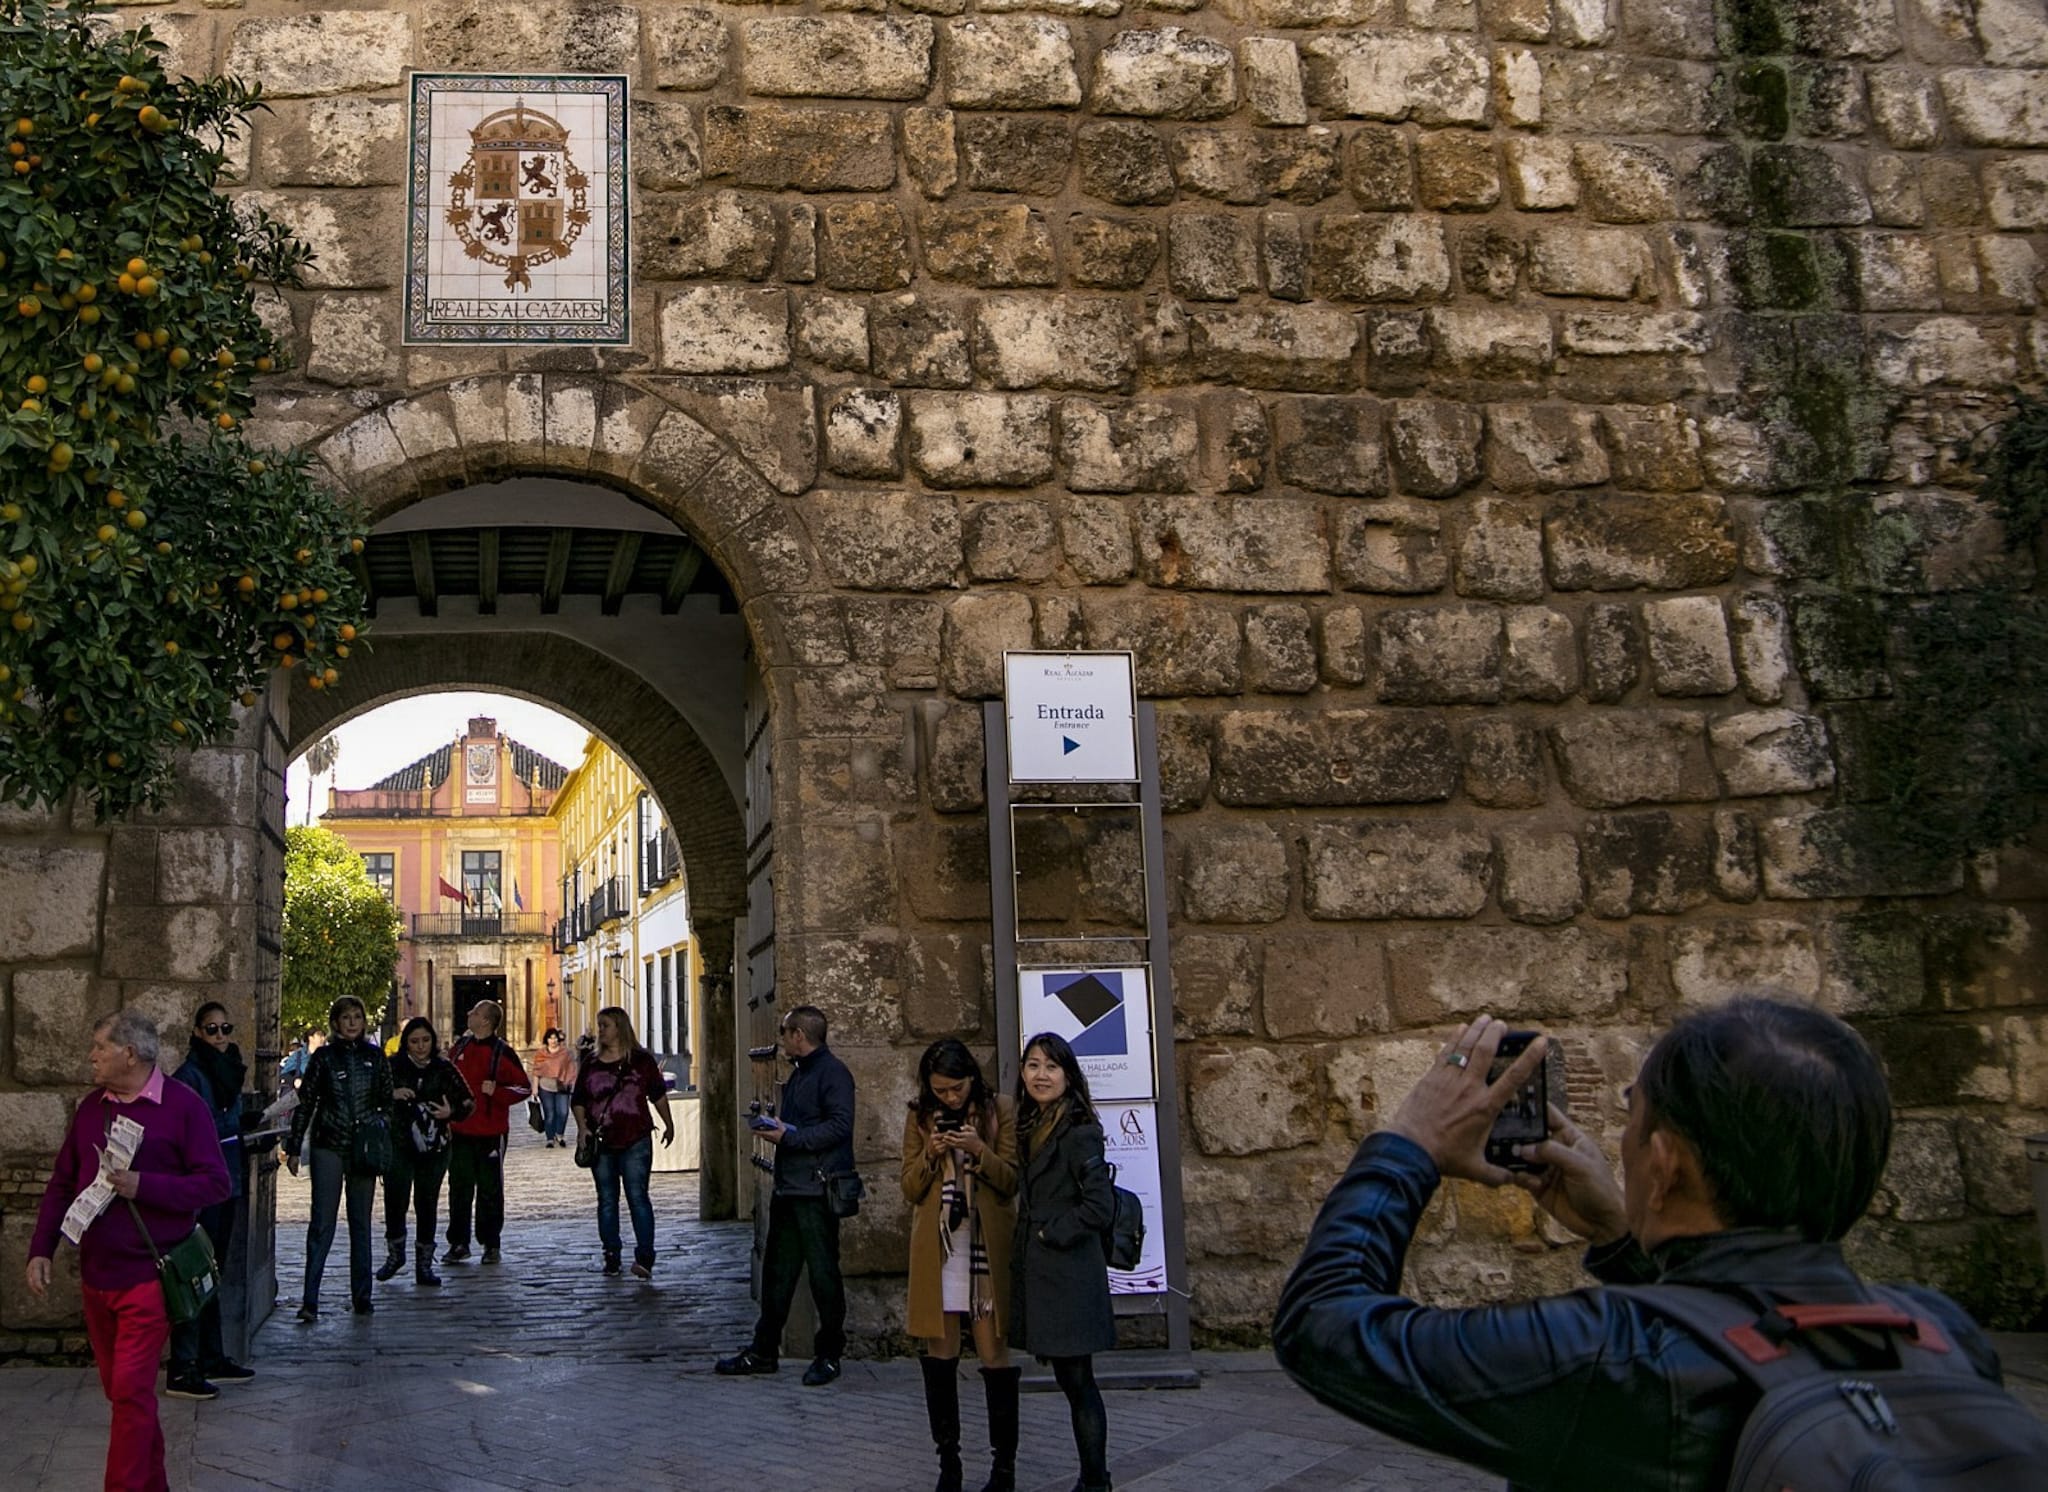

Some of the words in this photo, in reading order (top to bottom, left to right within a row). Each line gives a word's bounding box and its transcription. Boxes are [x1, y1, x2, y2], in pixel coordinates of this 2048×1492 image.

[434, 301, 498, 318] REALES
[501, 302, 601, 319] ALCAZARES
[1037, 704, 1105, 720] Entrada
[1054, 721, 1090, 729] Entrance
[1087, 1062, 1128, 1072] HALLADAS
[1121, 1133, 1146, 1146] 2018
